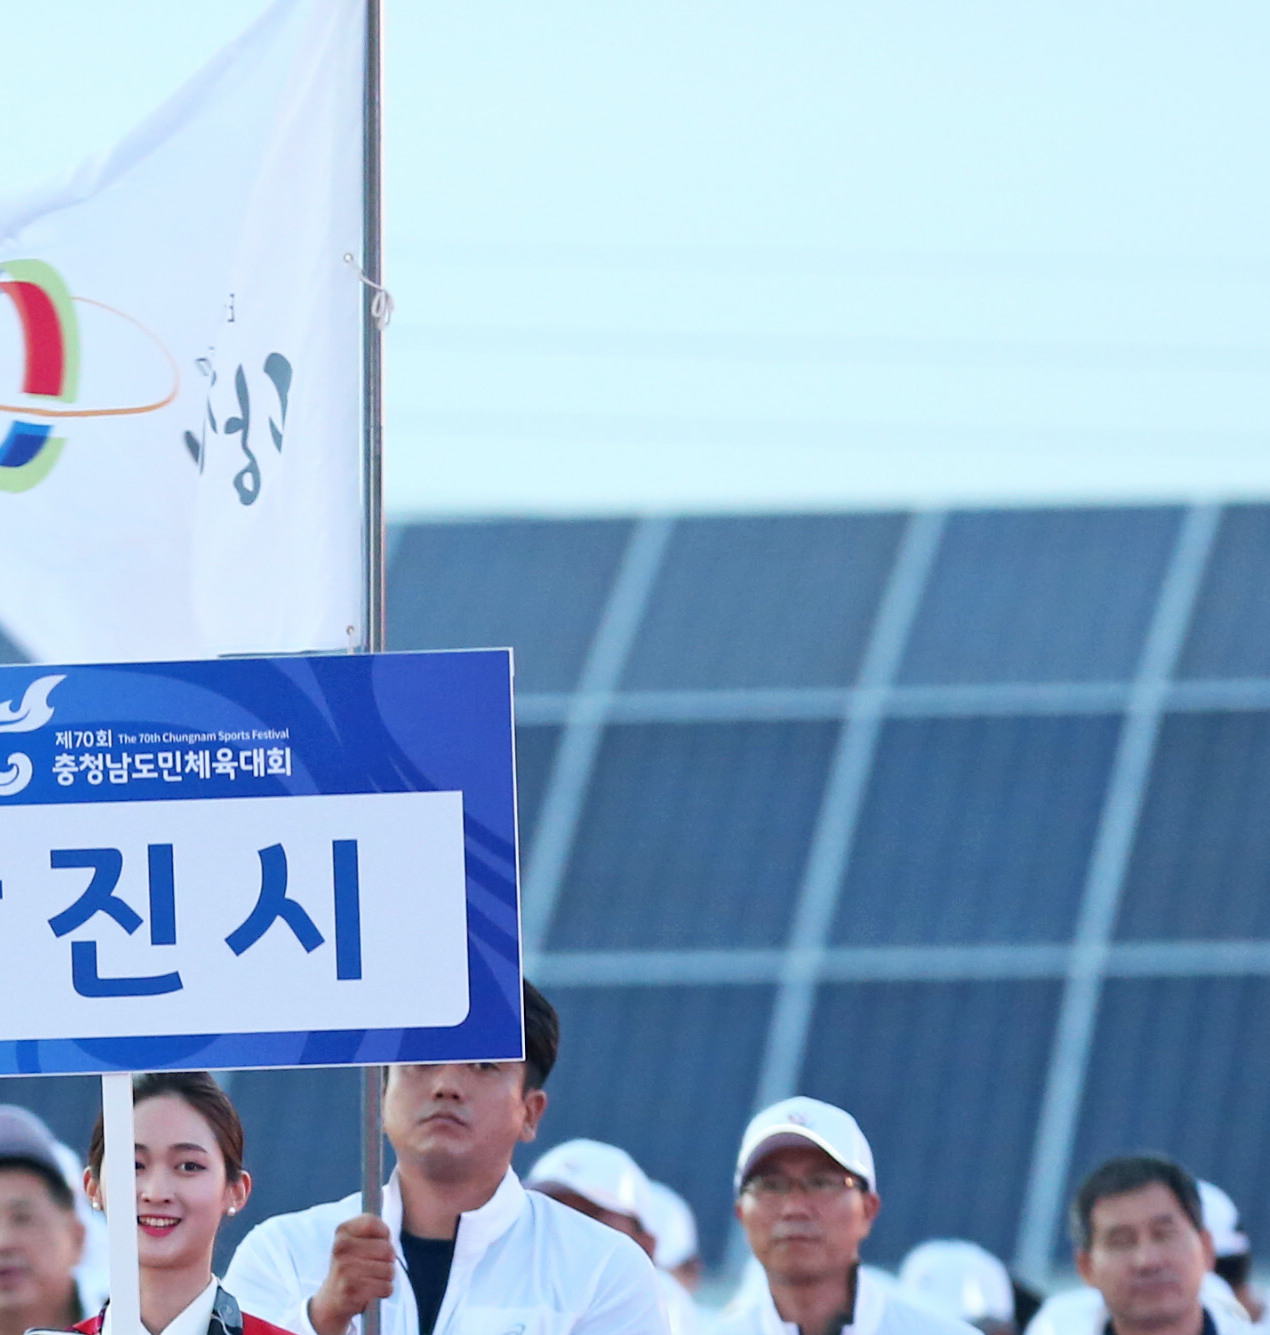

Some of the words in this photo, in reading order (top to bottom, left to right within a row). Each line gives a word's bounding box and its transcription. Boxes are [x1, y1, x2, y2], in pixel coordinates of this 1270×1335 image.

[55, 729, 112, 749] 제70회
[118, 733, 137, 744] The
[138, 732, 161, 744] 70th
[162, 731, 217, 745] Chungnam
[218, 730, 250, 743] Sports
[252, 728, 289, 740] Festival
[52, 747, 292, 786] 충청남도민체육대회
